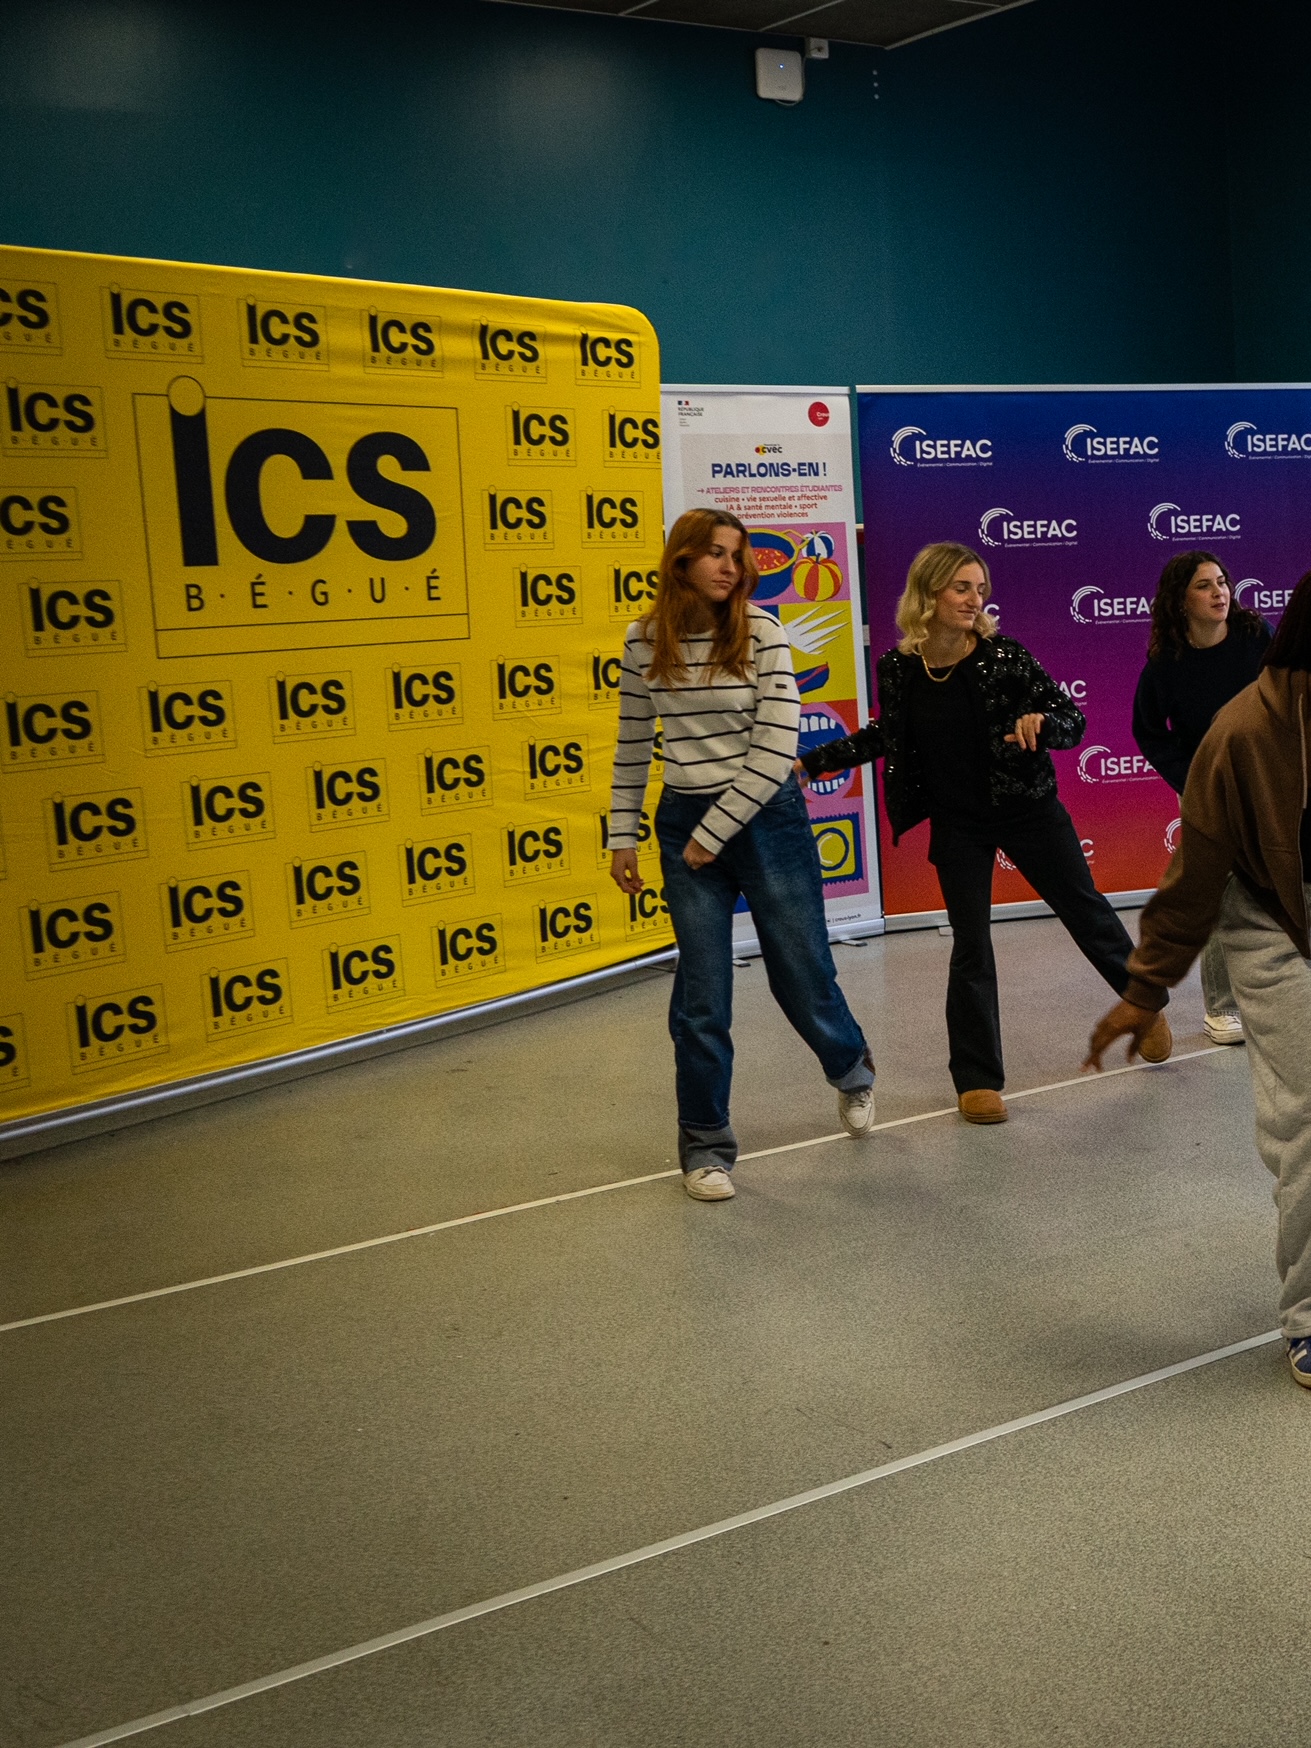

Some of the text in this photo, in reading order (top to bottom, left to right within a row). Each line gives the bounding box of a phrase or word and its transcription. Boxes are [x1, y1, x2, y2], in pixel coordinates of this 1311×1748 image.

[109, 283, 192, 340] ICS
[246, 295, 320, 349] ICS
[368, 305, 435, 357] ICS
[478, 317, 539, 363] ICS
[579, 326, 635, 369] ICS
[7, 378, 95, 434] ICS
[512, 403, 569, 447] ICS
[609, 407, 660, 450] ICS
[761, 446, 783, 454] cvec
[915, 439, 993, 459] ISEFAC
[1086, 436, 1159, 456] ISEFAC
[168, 375, 437, 567] ICS
[705, 483, 843, 495] ATELIERS ET RENCONTRES ÉTUDIANTES
[711, 462, 827, 478] PARLONS-EN !
[0, 495, 70, 536] CS
[489, 487, 547, 530] ICS
[586, 487, 639, 529] ICS
[714, 496, 740, 504] cuisine
[758, 494, 787, 502] sexuelle
[788, 494, 796, 502] et
[797, 493, 828, 501] affective
[743, 502, 763, 510] santé
[764, 502, 793, 510] mentale
[798, 502, 818, 511] sport
[776, 510, 809, 518] violences
[1003, 519, 1078, 539] ISEFAC
[1170, 513, 1241, 533] ISEFAC
[29, 578, 115, 632] ICS
[520, 564, 576, 607] ICS
[1253, 589, 1294, 609] ISEF
[392, 664, 455, 709] ICS
[497, 656, 555, 700] ICS
[592, 648, 621, 691] IC
[148, 682, 226, 733] ICS
[277, 672, 346, 720] ICS
[5, 692, 92, 747] ICS
[425, 749, 485, 794] ICS
[528, 737, 584, 780] ICS
[1100, 755, 1157, 776] ISEFA
[190, 777, 265, 827] ICS
[313, 762, 381, 810] ICS
[53, 792, 136, 846] ICS
[405, 839, 467, 885] ICS
[507, 823, 563, 866] ICS
[168, 878, 244, 928] ICS
[293, 857, 361, 905] ICS
[29, 900, 114, 954] ICS
[438, 921, 497, 966] ICS
[539, 900, 593, 943] ICS
[329, 943, 395, 991] ICS
[209, 968, 283, 1018] ICS
[75, 995, 157, 1049] ICS
